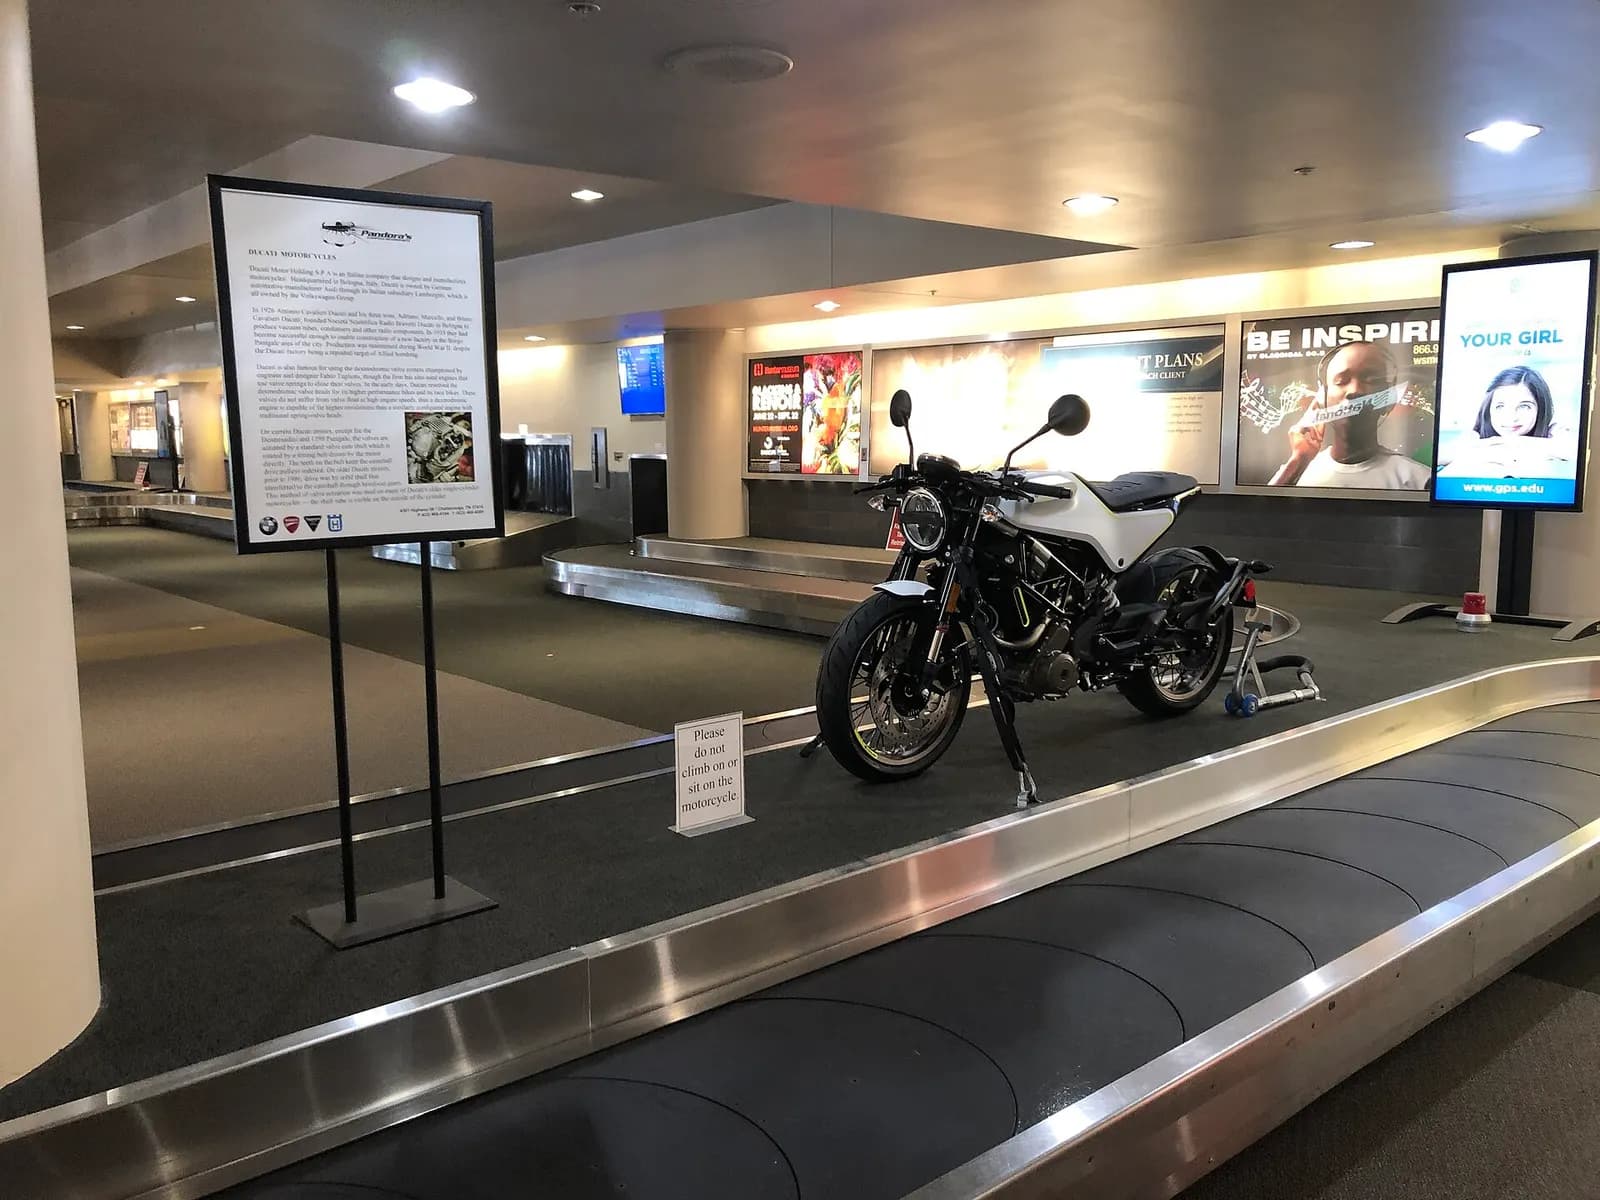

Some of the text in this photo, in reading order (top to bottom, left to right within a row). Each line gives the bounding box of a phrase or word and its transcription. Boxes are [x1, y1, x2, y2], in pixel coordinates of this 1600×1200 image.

[361, 230, 412, 240] Pandora's
[248, 249, 336, 260] DUCATI MOTORCYCLES
[1247, 329, 1290, 352] BE
[1460, 329, 1563, 348] YOUR GIRL
[1154, 352, 1203, 368] PLANS
[1159, 371, 1186, 380] CLIENT
[1463, 483, 1544, 494] www.gps.edu
[694, 728, 725, 742] Please
[694, 744, 725, 758] do not
[682, 758, 738, 778] climb on or
[688, 776, 733, 794] sit on the
